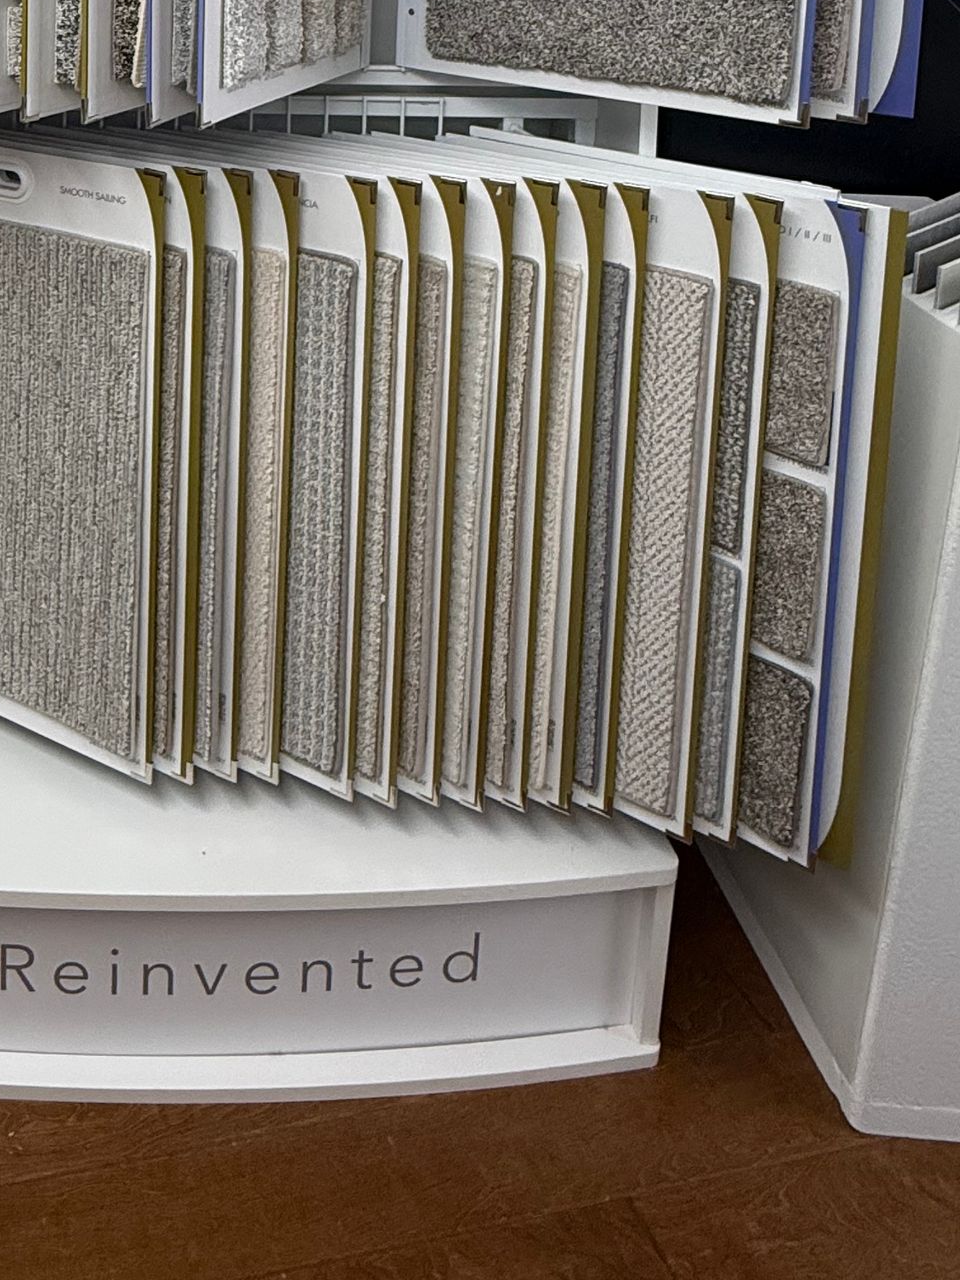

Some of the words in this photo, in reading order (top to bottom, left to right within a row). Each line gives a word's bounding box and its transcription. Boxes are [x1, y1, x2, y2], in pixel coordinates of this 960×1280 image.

[60, 185, 93, 199] SMOOTH
[95, 192, 127, 205] SAILING
[0, 931, 482, 996] Reinvented
